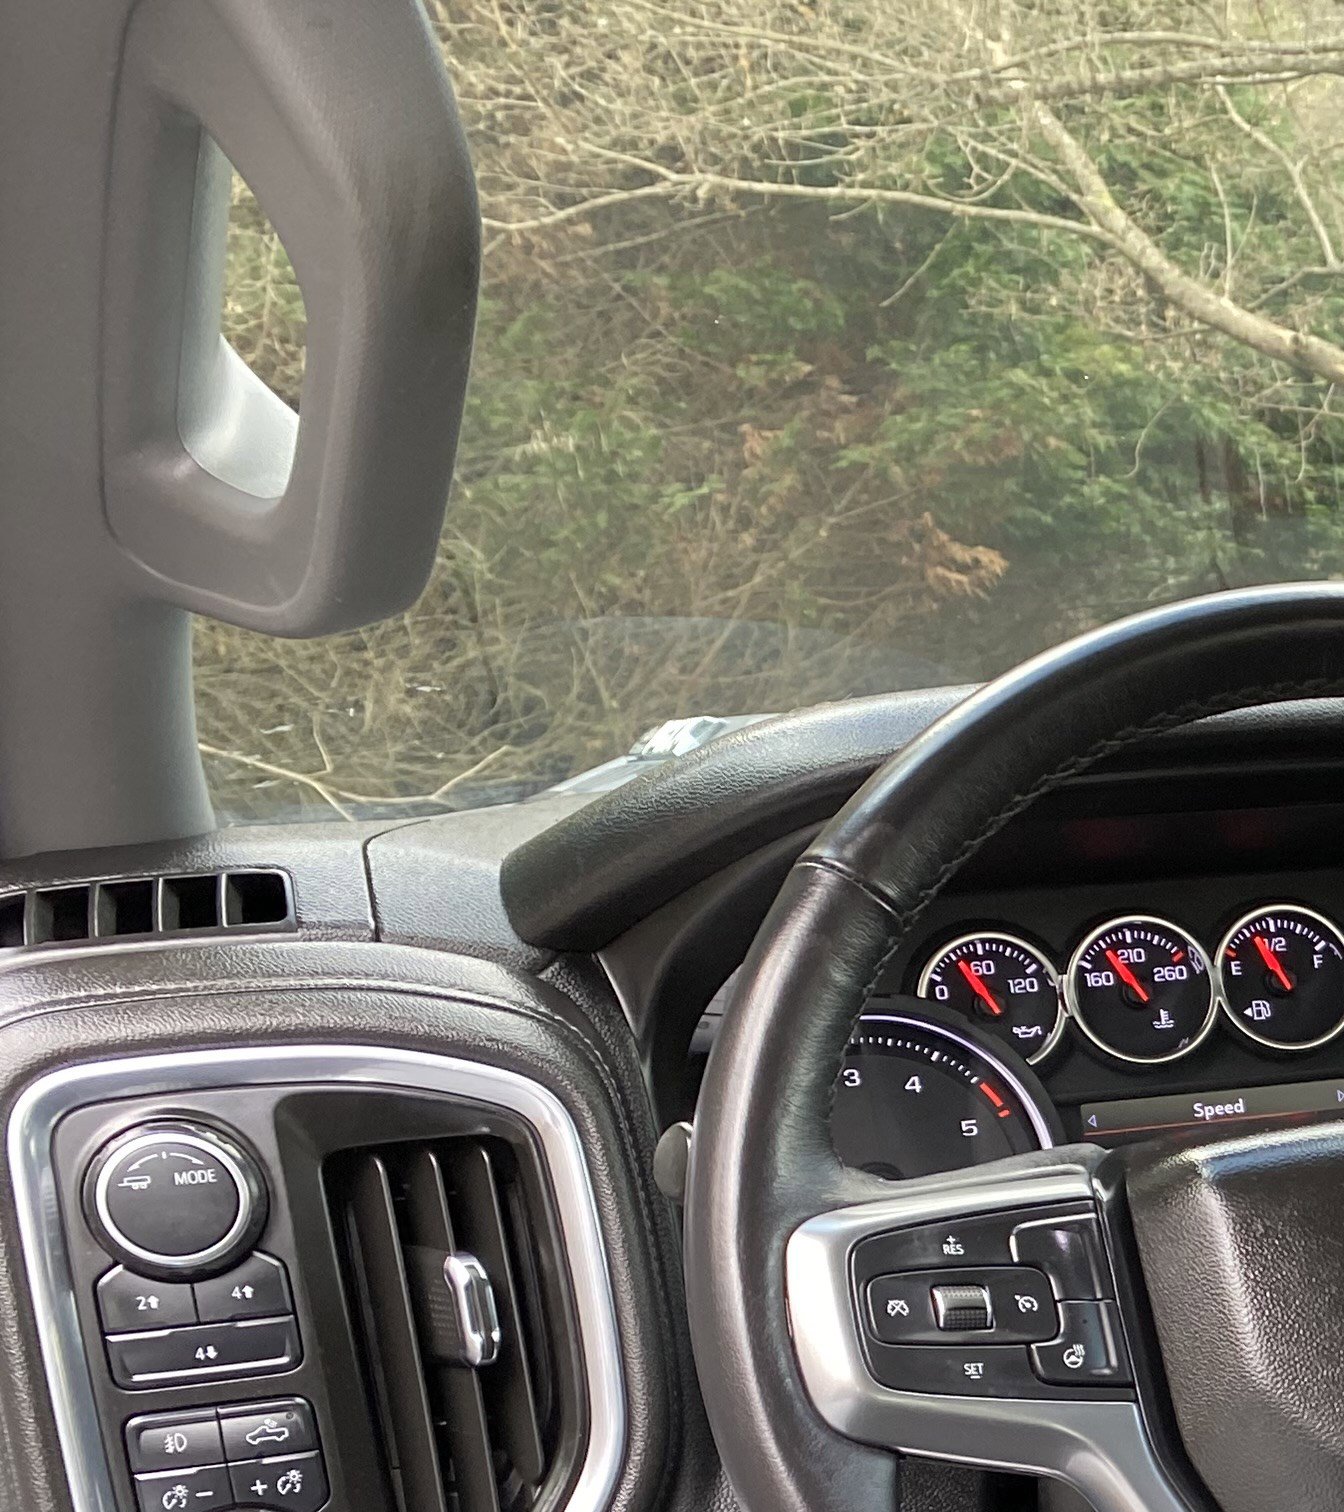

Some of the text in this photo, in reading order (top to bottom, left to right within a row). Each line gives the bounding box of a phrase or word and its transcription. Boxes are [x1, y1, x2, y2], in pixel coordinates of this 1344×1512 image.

[1117, 948, 1145, 964] 210
[1313, 954, 1323, 969] F
[970, 960, 995, 976] 60
[1153, 965, 1187, 983] 260
[1231, 961, 1242, 975] E
[1007, 977, 1038, 994] 120
[1084, 971, 1115, 988] 160
[935, 985, 948, 1000] 0
[843, 1069, 861, 1087] 3
[904, 1076, 922, 1093] 4
[1193, 1098, 1245, 1119] Speed
[962, 1119, 978, 1137] 5
[173, 1169, 217, 1185] MODE
[943, 1243, 964, 1255] RES
[964, 1363, 984, 1376] SET
